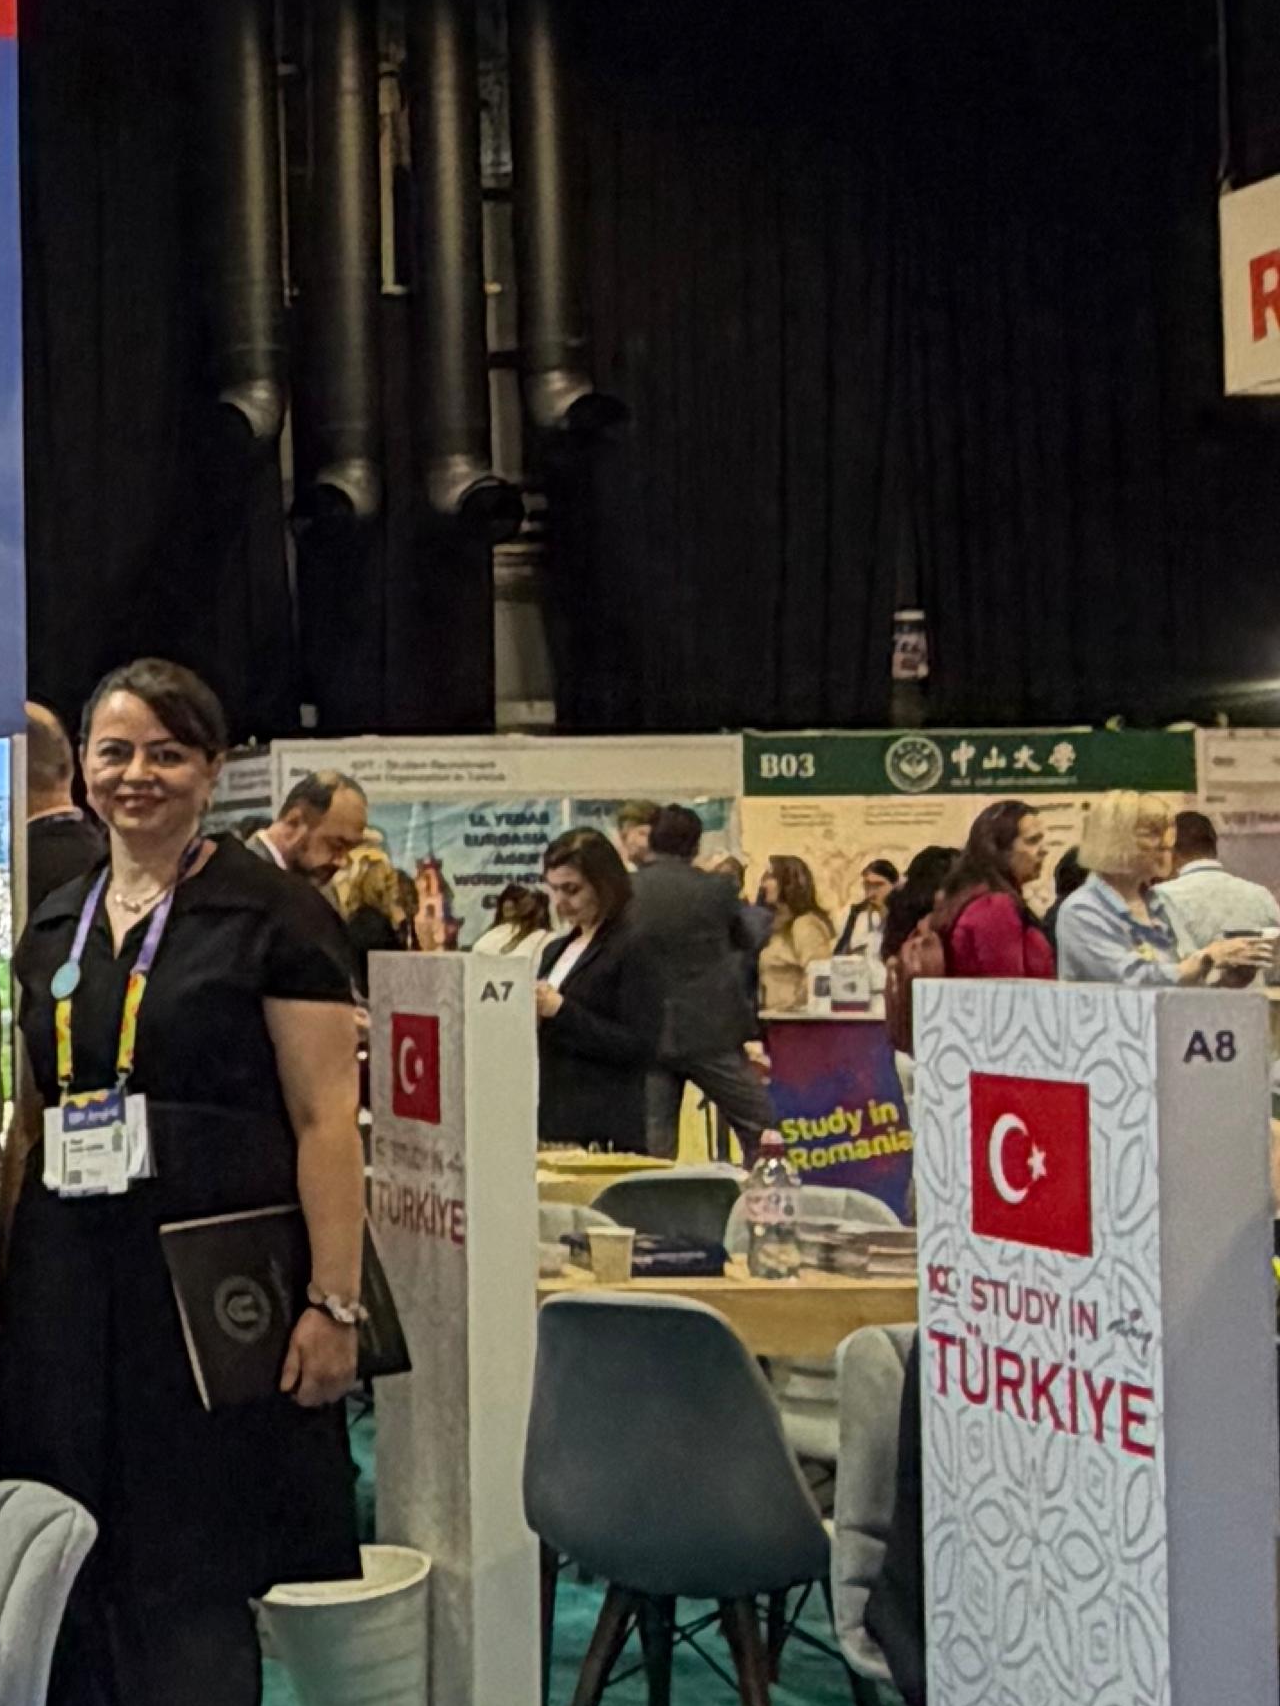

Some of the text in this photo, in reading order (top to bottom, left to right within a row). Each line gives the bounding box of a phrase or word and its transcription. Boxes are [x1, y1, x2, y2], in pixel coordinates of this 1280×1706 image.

[760, 752, 816, 778] B03
[480, 981, 514, 1004] A7
[1182, 1030, 1238, 1063] A8
[781, 1098, 900, 1143] Study in
[787, 1126, 914, 1171] Romania
[971, 1274, 1062, 1330] STUDY
[1069, 1294, 1099, 1342] IN
[928, 1321, 1156, 1460] TÜRKİYE
